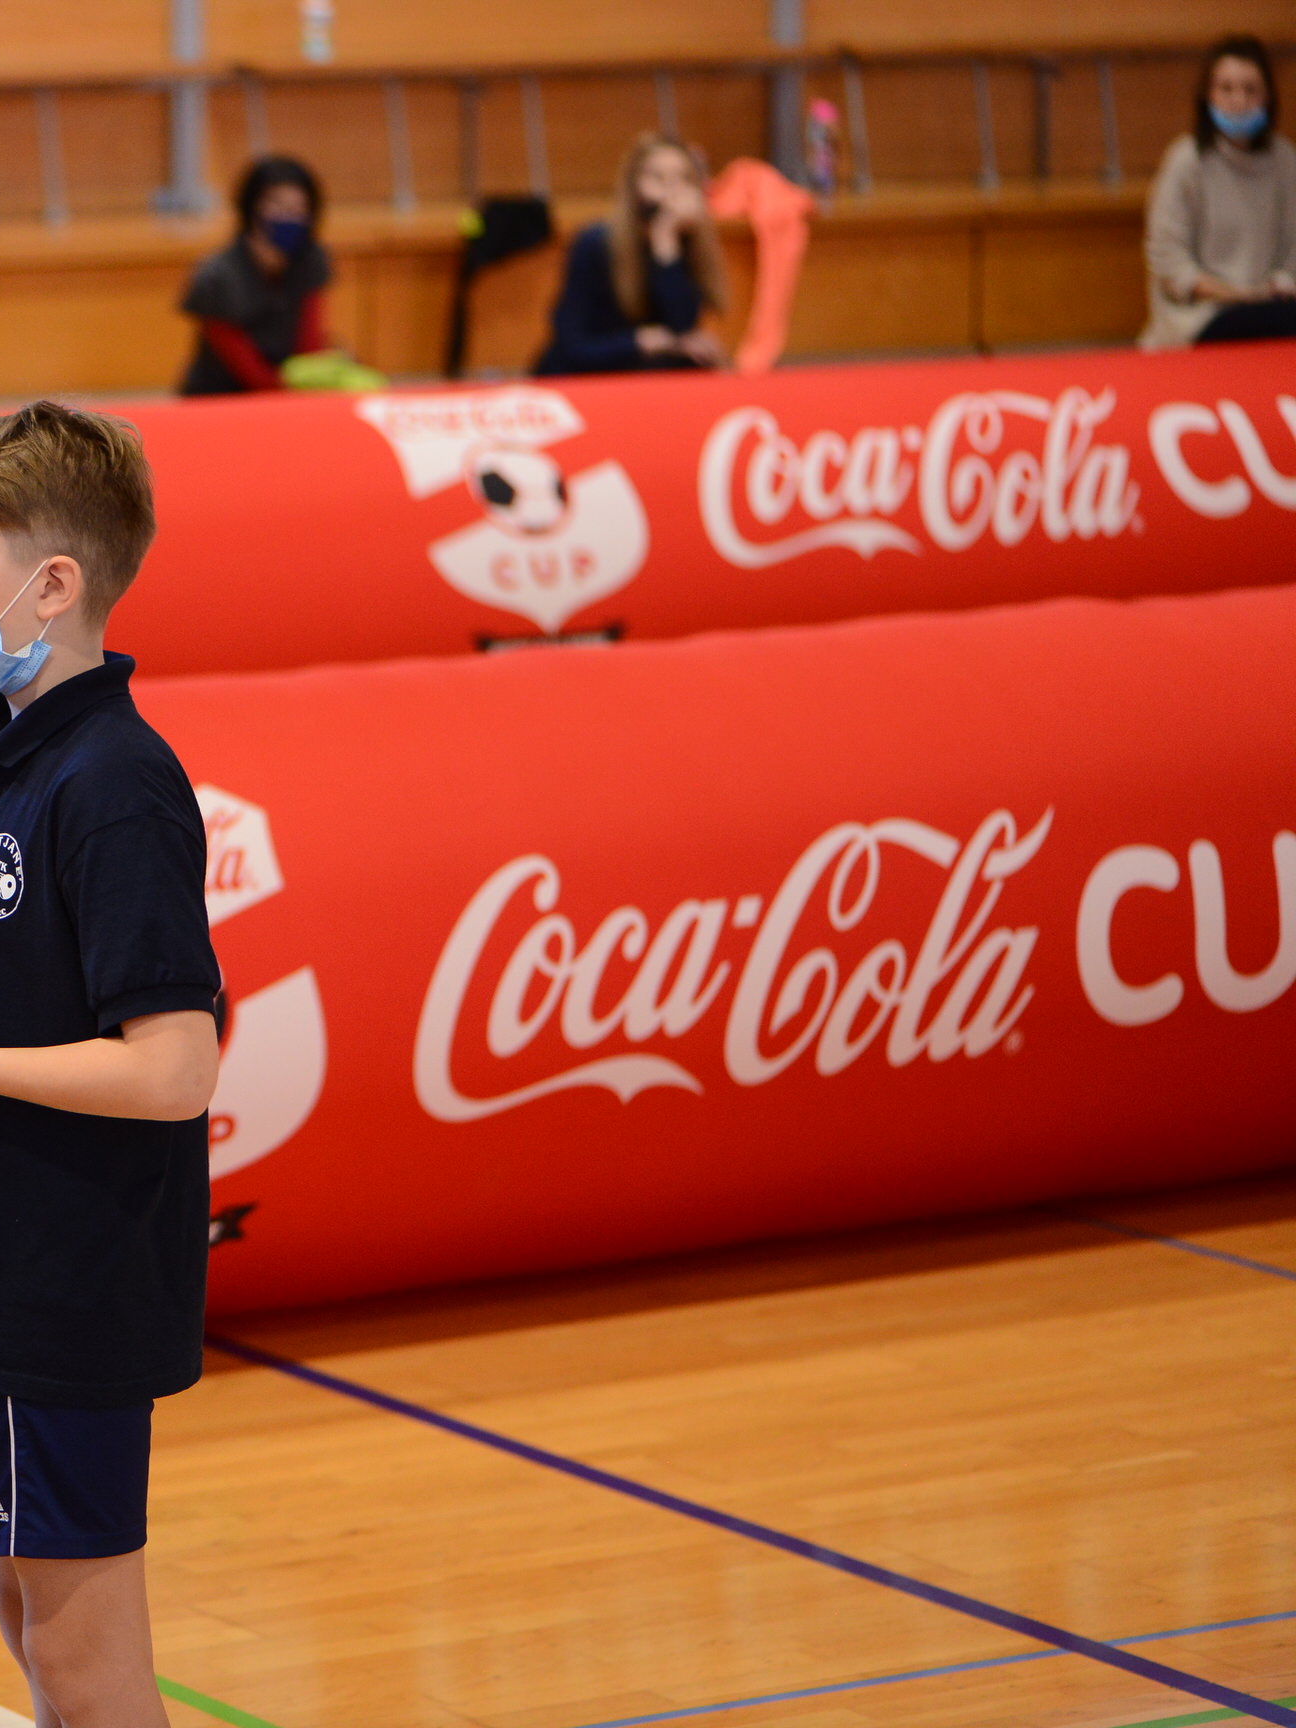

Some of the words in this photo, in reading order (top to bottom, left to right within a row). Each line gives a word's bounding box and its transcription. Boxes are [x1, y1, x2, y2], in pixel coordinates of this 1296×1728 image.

[488, 546, 597, 593] CUP
[698, 386, 1141, 570] Coca-Cola
[1146, 394, 1296, 520] CU
[412, 804, 1055, 1123] Coca-Cola
[1076, 829, 1296, 1026] CU
